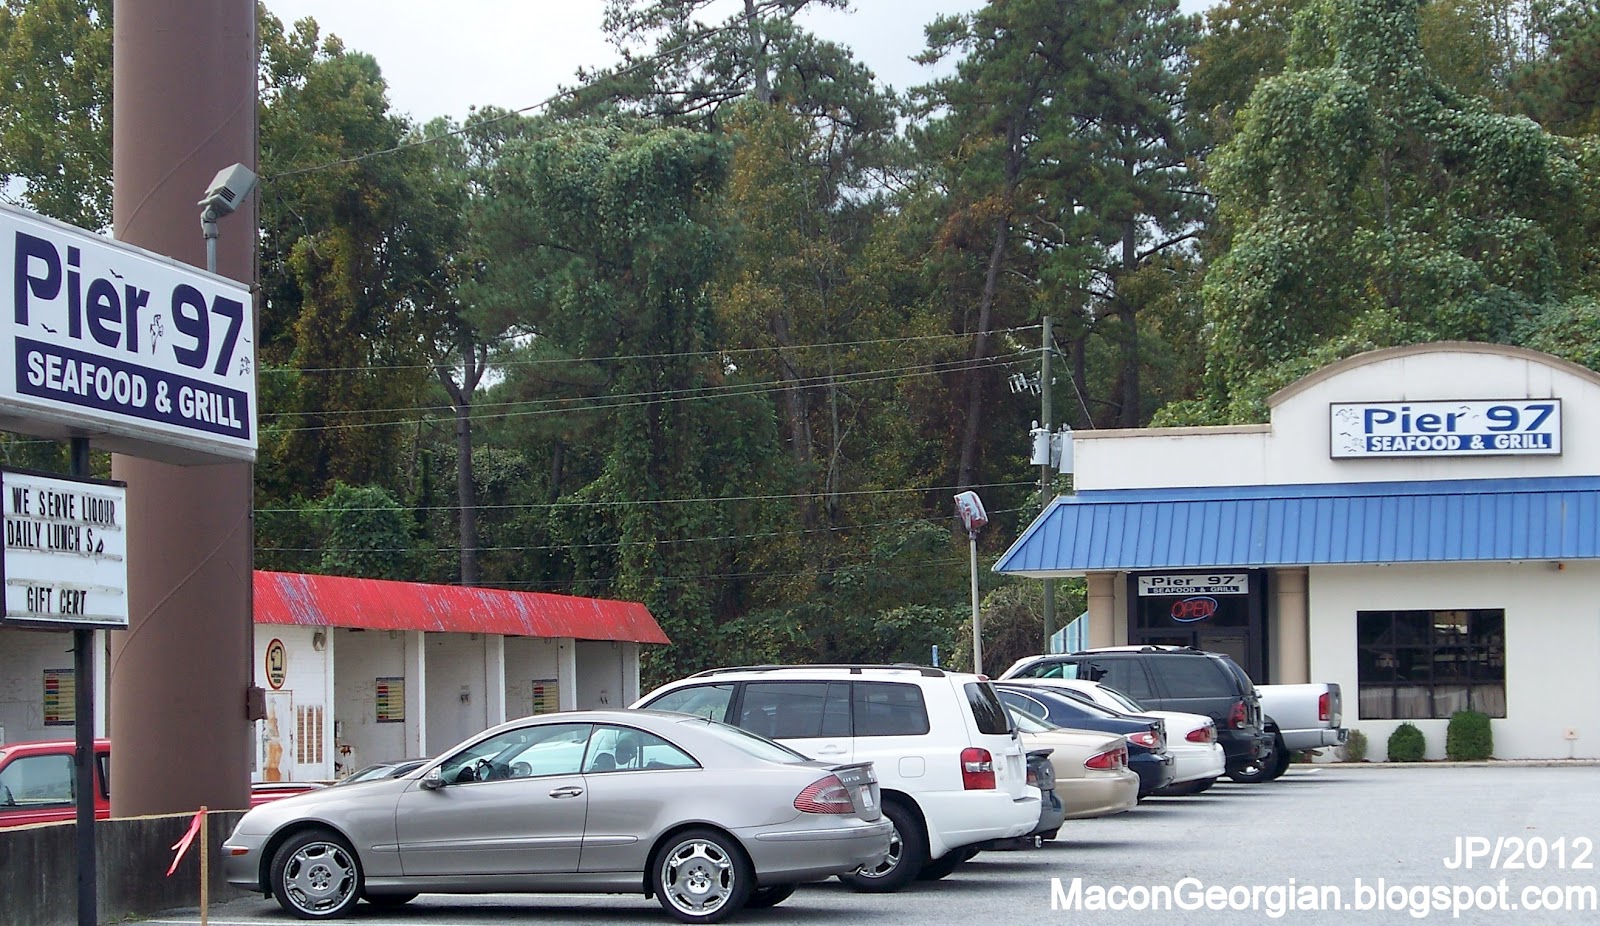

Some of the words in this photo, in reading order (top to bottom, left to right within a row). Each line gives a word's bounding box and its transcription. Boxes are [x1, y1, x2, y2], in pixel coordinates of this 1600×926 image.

[14, 231, 150, 353] Pier
[171, 284, 243, 377] 97
[27, 351, 147, 408] SEAFOOD
[155, 380, 171, 414] &
[179, 386, 242, 429] GRILL
[1364, 406, 1467, 434] Pier
[1486, 404, 1555, 432] 97
[1371, 435, 1461, 451] SEAFOOD
[1470, 434, 1485, 450] &
[1494, 433, 1548, 449] GRILL
[12, 487, 30, 514] WE
[38, 491, 75, 519] SERVE
[7, 520, 41, 548] DAILY
[48, 523, 80, 551] LUNCH
[1151, 577, 1193, 586] Pier
[1207, 576, 1235, 585] 97
[27, 586, 52, 613] GIFT
[60, 588, 87, 615] CERT
[1171, 601, 1215, 618] OPEN
